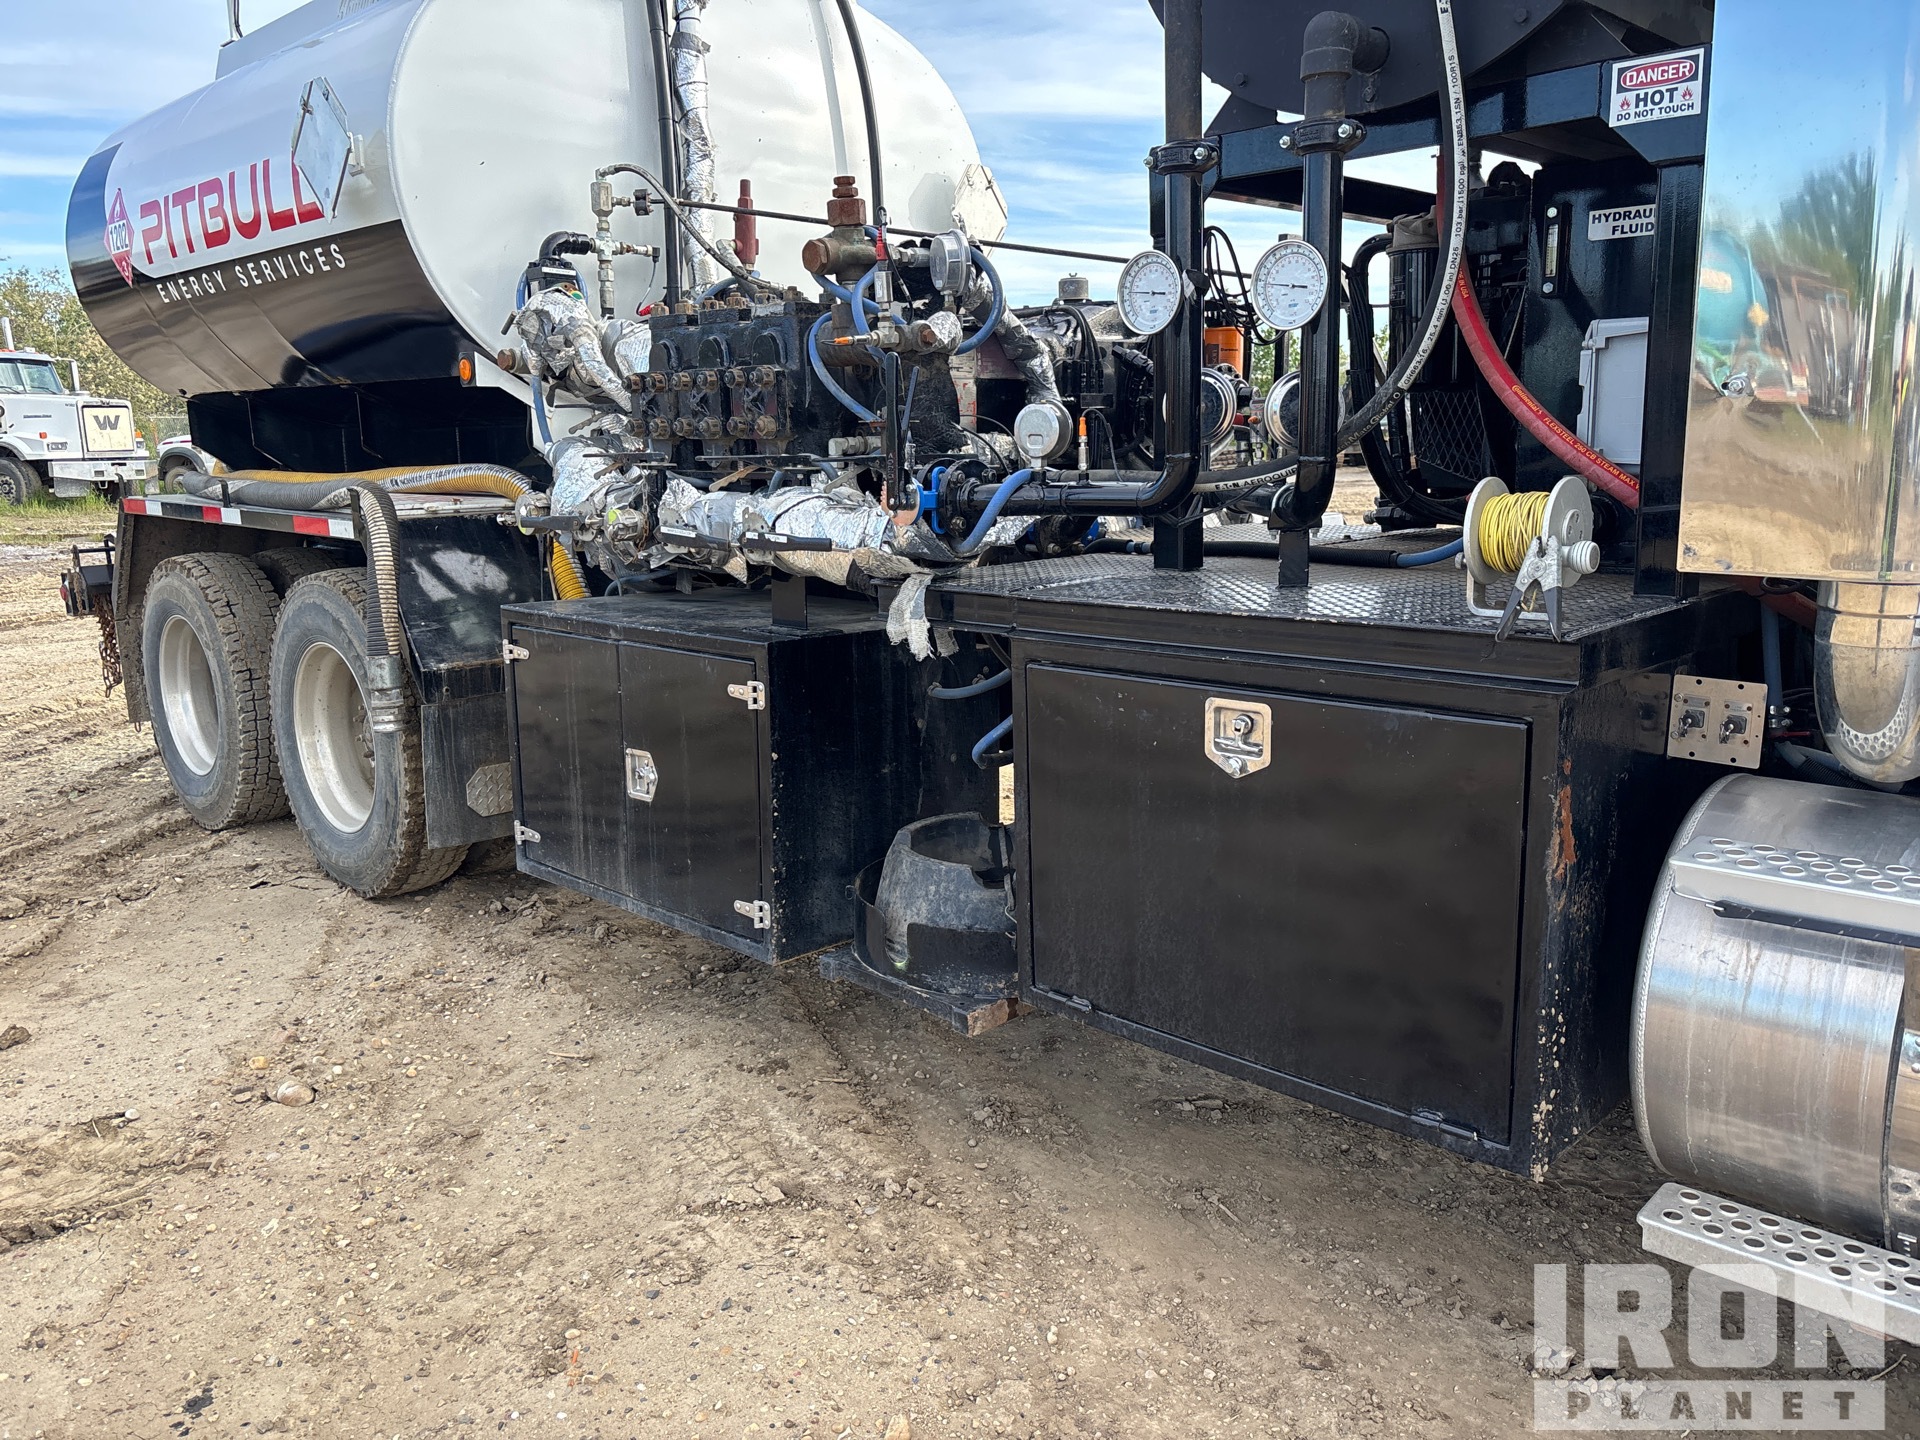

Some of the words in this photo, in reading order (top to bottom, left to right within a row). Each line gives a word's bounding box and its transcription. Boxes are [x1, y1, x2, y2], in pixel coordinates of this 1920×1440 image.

[1626, 62, 1690, 86] DANGER
[1634, 87, 1679, 109] HOT
[1616, 112, 1631, 122] DO
[1633, 108, 1655, 119] NOT
[1658, 102, 1694, 115] TOUCH
[140, 150, 326, 265] PITBULL
[1456, 205, 1464, 219] bar
[109, 223, 129, 252] 1202
[1455, 221, 1463, 238] 103
[1611, 222, 1655, 235] FLUID
[121, 261, 129, 276] 3
[1449, 246, 1460, 270] DN25
[156, 270, 226, 303] ENERGY
[235, 243, 346, 288] SERVICES
[1369, 400, 1395, 425] Global
[1511, 384, 1540, 413] Continental
[1543, 417, 1575, 445] FLEXSTEEL
[1574, 442, 1587, 453] 250
[1595, 456, 1619, 475] STEAM
[1619, 472, 1634, 486] MAX
[1243, 468, 1298, 487] AEROQUIP
